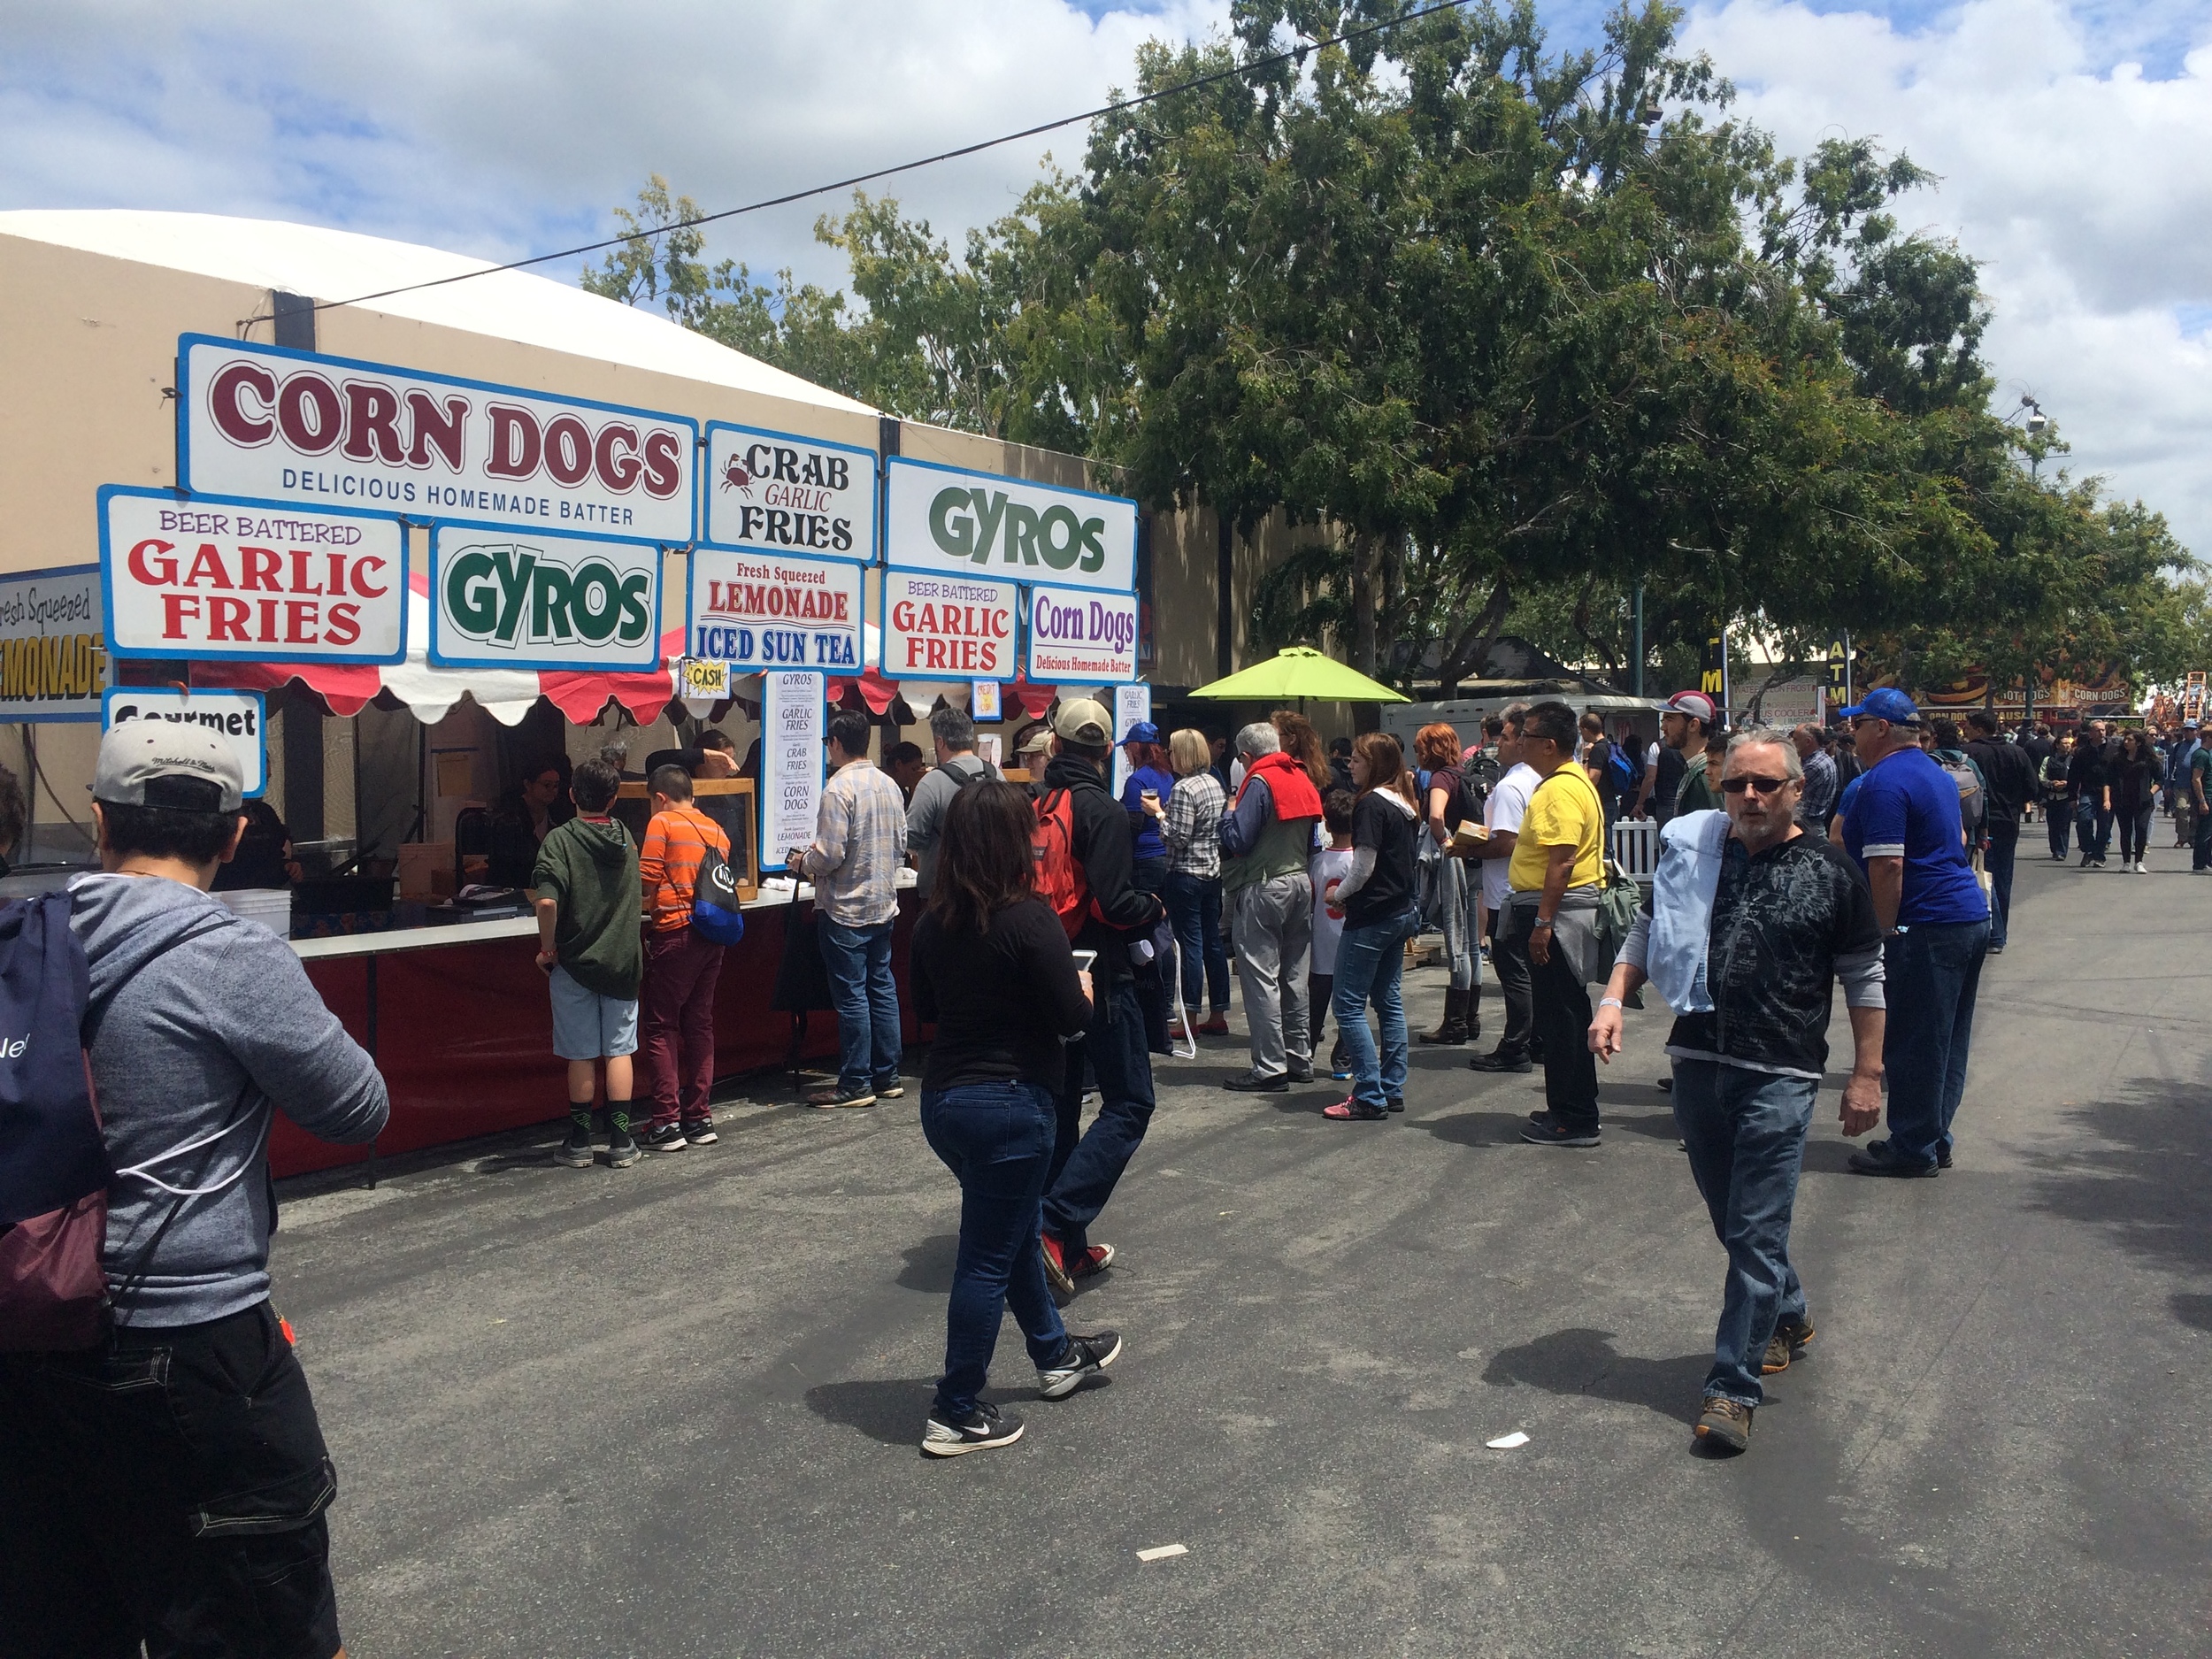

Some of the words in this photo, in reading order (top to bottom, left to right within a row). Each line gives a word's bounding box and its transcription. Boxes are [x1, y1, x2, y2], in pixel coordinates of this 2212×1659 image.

[210, 363, 470, 472] CORN
[485, 404, 680, 497] DOGS
[747, 443, 849, 490] CRAB
[282, 469, 416, 502] DELICIOUS
[427, 485, 550, 517] HOMEMADE
[559, 501, 633, 526] BATTER
[764, 483, 832, 512] GARLIC
[159, 510, 229, 535] BEER
[236, 517, 362, 546] BATTERED
[739, 504, 853, 551] FRIES
[928, 487, 1105, 573] GYROS
[127, 539, 388, 598] GARLIC
[736, 563, 770, 580] Fresh
[774, 566, 826, 585] Squeezed
[445, 548, 650, 645] GYROS
[708, 581, 849, 621] LEMONADE
[908, 580, 939, 597] BEER
[941, 585, 998, 603] BATTERED
[28, 587, 91, 635] Squeezed
[160, 594, 362, 646] FRIES
[893, 601, 1009, 639] GARLIC
[1035, 595, 1084, 640] Corn
[1088, 601, 1134, 654] Dogs
[696, 626, 753, 660] ICED
[762, 630, 807, 664] SUN
[814, 634, 856, 664] TEA
[905, 636, 997, 672] FRIES
[0, 633, 106, 702] MONADE
[693, 667, 722, 687] CASH
[782, 673, 812, 686] GYROS
[1036, 655, 1070, 671] Delicious
[1071, 657, 1110, 672] Homemade
[1110, 658, 1132, 673] Batter
[1828, 641, 1847, 704] ATM
[1786, 684, 1811, 693] FROST
[2074, 689, 2100, 702] CORN
[2101, 688, 2125, 701] DOGS
[781, 708, 813, 719] GARLIC
[786, 719, 809, 731] FRIES
[1774, 709, 1809, 718] COOLER
[786, 760, 807, 771] FRIES
[787, 748, 807, 758] CRAB
[783, 786, 810, 798] CORN
[784, 798, 809, 810] DOGS
[777, 831, 812, 841] LEMONADE
